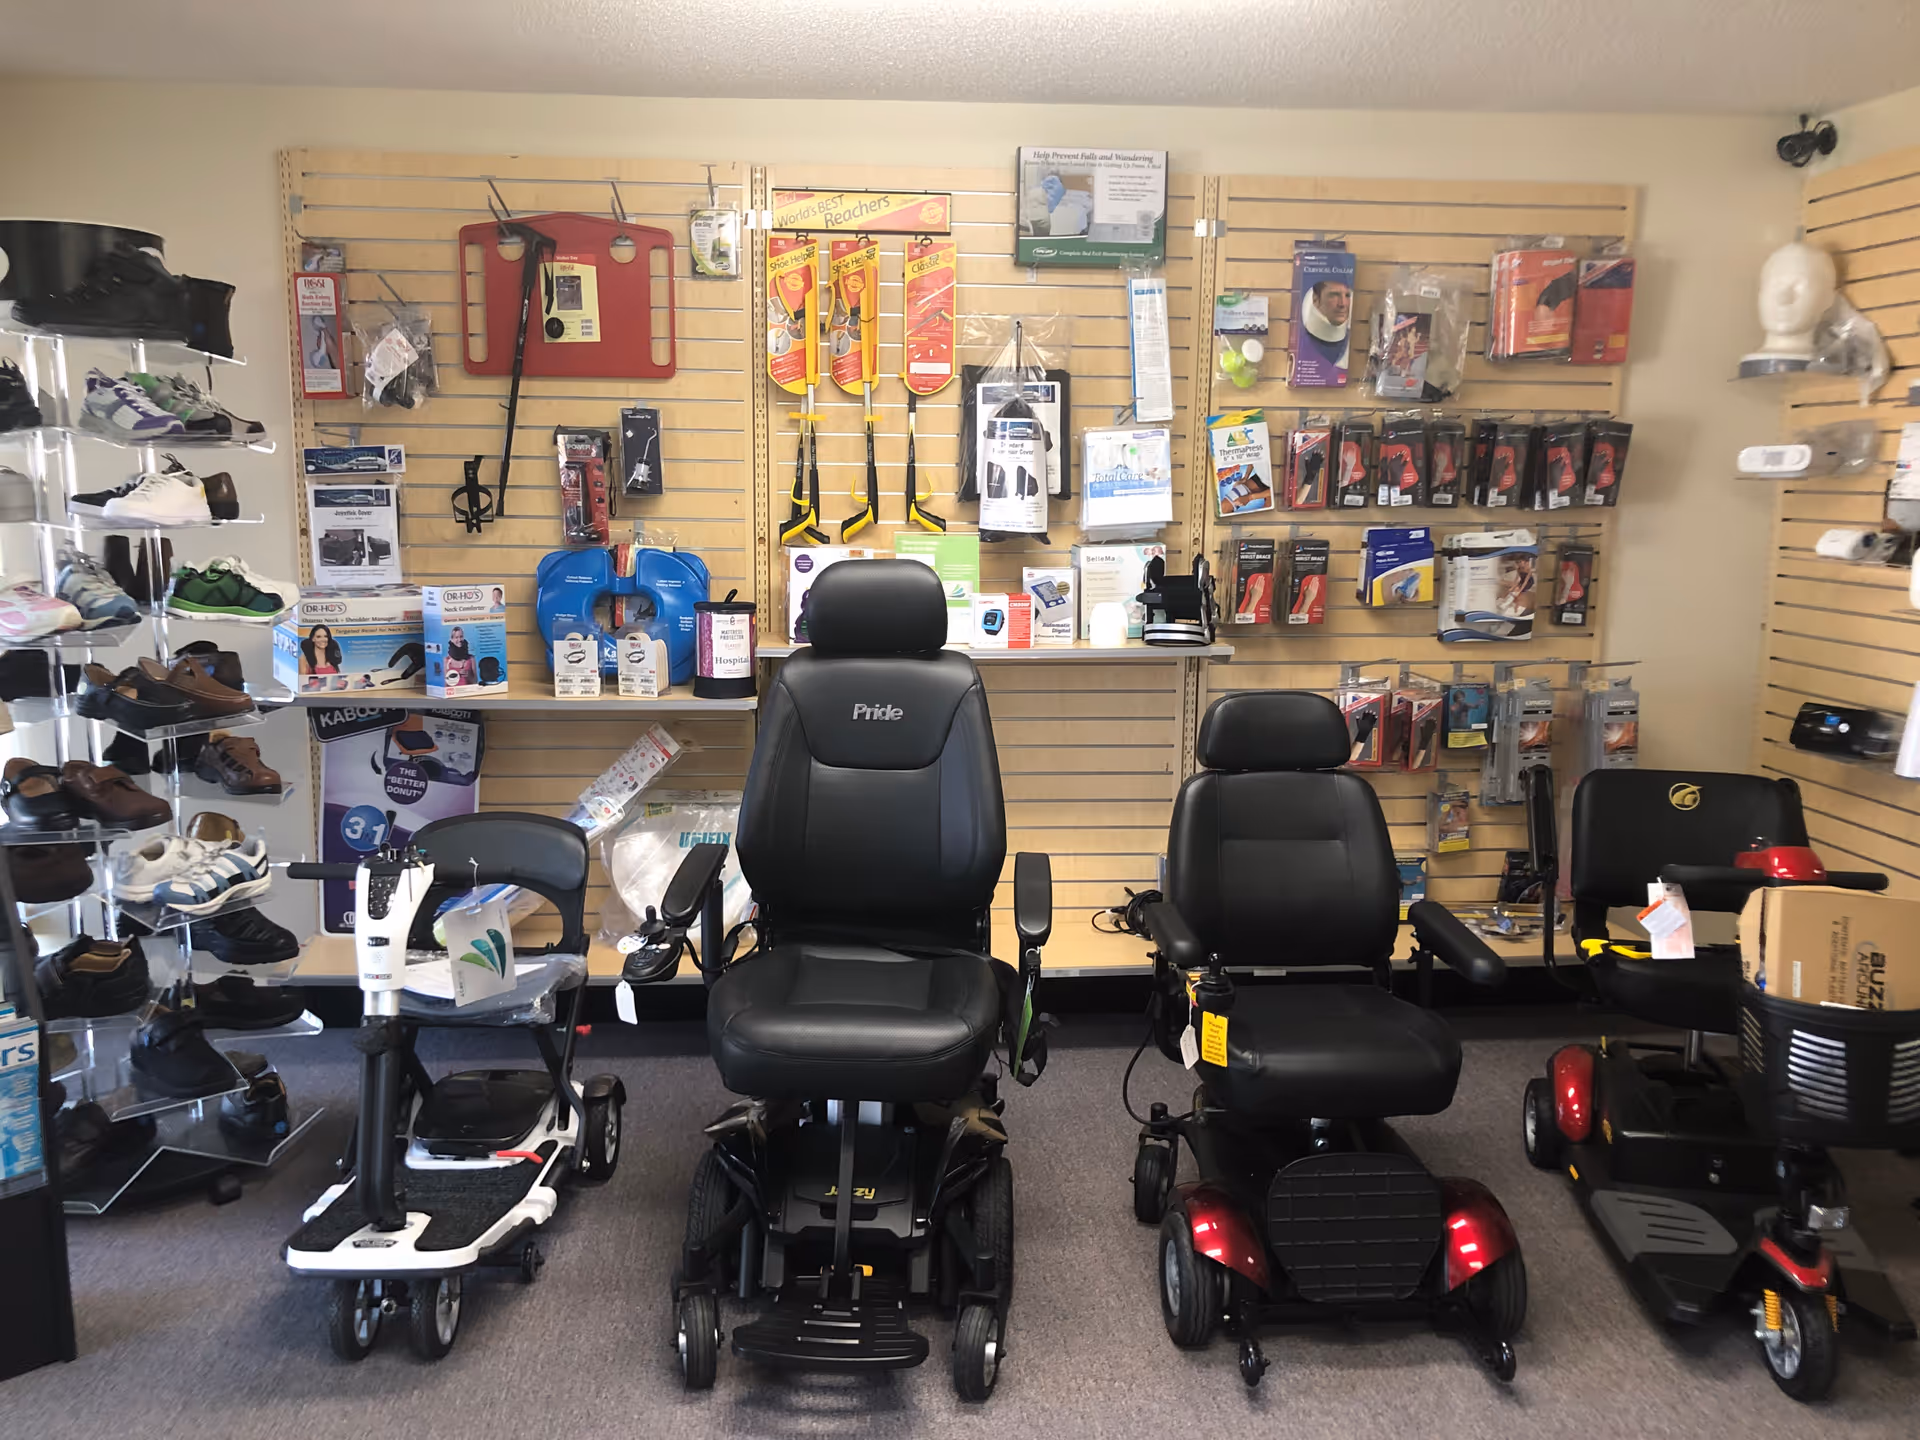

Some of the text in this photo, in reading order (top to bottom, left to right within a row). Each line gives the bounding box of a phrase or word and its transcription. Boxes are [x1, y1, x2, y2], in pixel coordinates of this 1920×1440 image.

[1033, 151, 1154, 163] Help Prevent Falls and Wandering
[777, 194, 845, 228] World's BEST
[823, 196, 890, 228] Reachers
[770, 251, 815, 272] Shoe Helper
[911, 255, 940, 274] Classic
[1219, 444, 1263, 456] ThermaPress
[1093, 471, 1144, 483] Total Care
[306, 604, 343, 613] DR-HO'S
[715, 656, 750, 666] Hospital
[320, 707, 398, 728] KABOO
[852, 703, 904, 721] Pride
[400, 767, 417, 777] THE
[387, 776, 426, 789] "BETTER
[386, 786, 423, 797] DONUT"
[345, 816, 366, 839] 3
[373, 823, 387, 845] 1
